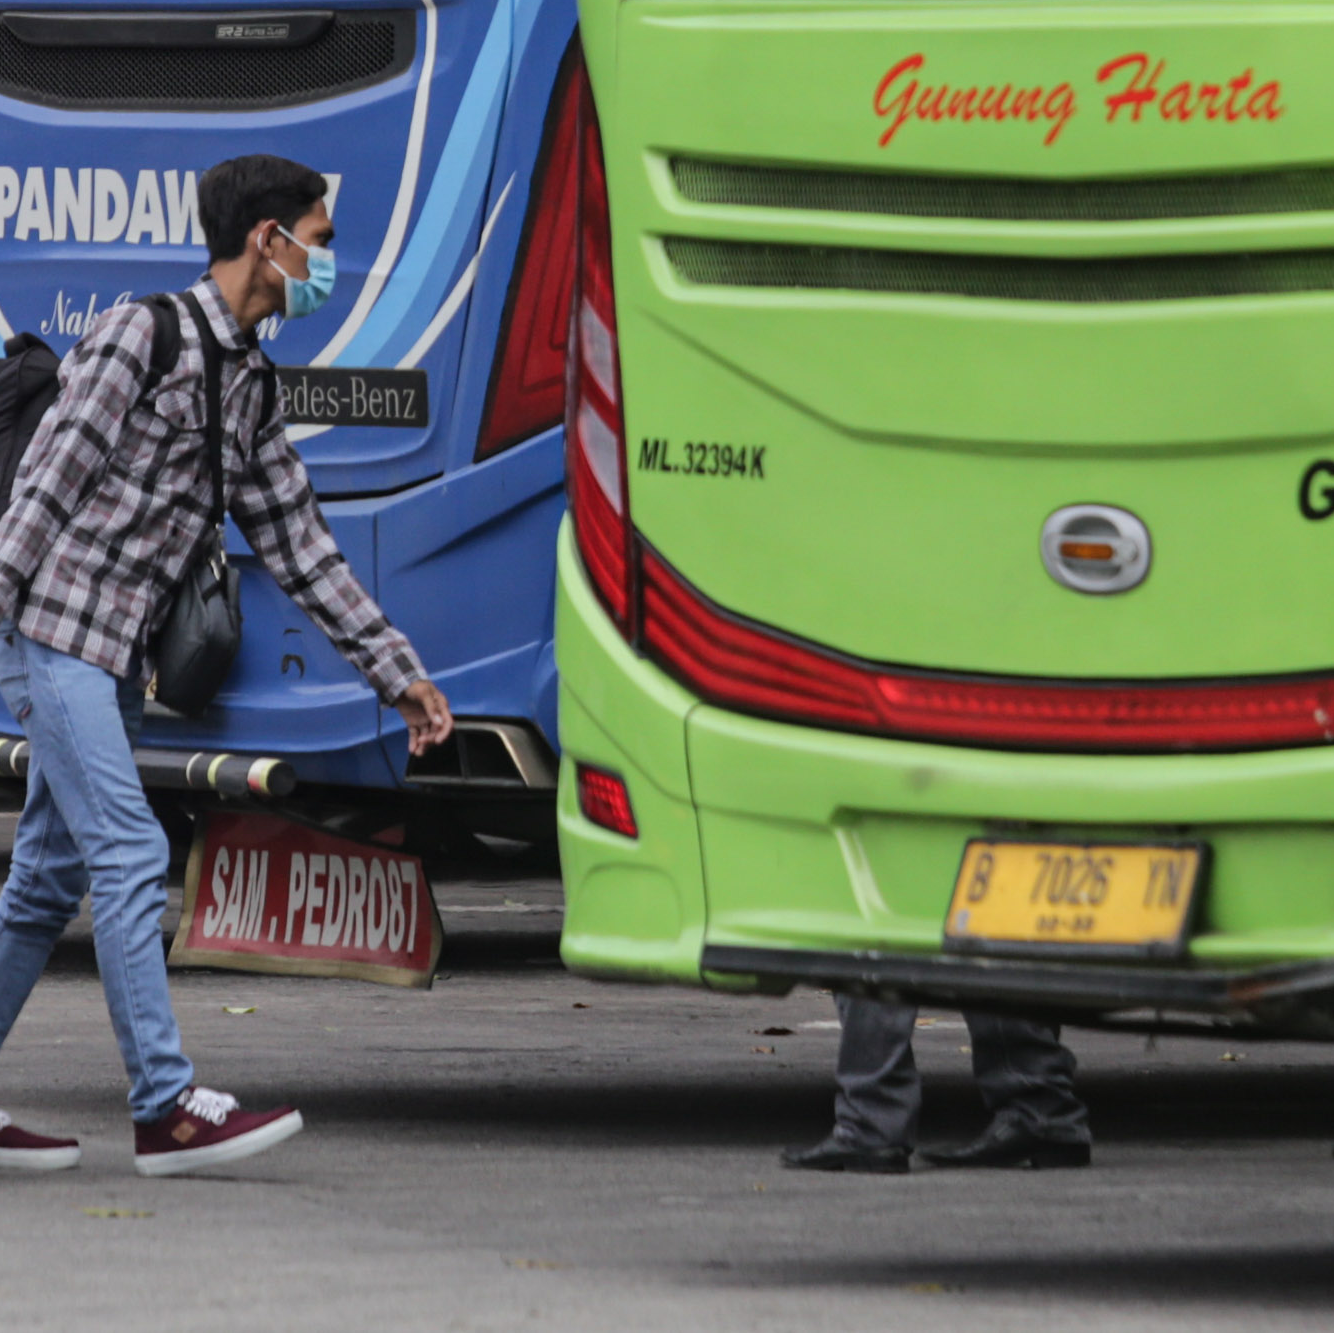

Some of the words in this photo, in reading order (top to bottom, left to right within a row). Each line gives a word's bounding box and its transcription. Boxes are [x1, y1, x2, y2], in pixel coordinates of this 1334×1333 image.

[872, 52, 1077, 149] Gunung
[1096, 52, 1285, 124] Harta
[279, 377, 417, 420] edes-Benz
[639, 439, 766, 480] ML.32394K
[203, 845, 270, 941] SAM
[283, 850, 418, 954] PEDRO87
[967, 852, 996, 904] B
